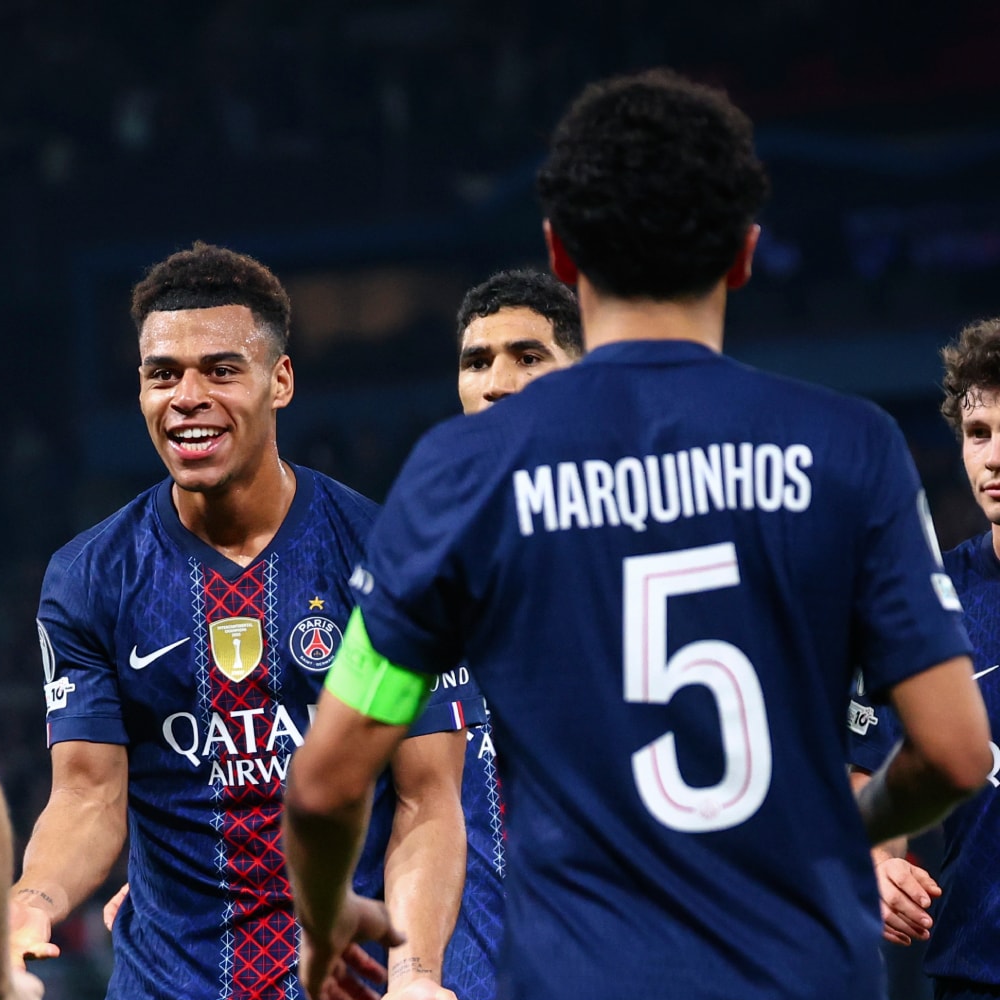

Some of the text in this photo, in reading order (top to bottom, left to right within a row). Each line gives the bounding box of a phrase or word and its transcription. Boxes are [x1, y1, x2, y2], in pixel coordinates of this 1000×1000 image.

[513, 442, 814, 536] MARQUINHOS
[298, 618, 335, 634] PARIS
[622, 541, 773, 834] 5
[162, 704, 318, 768] QATA
